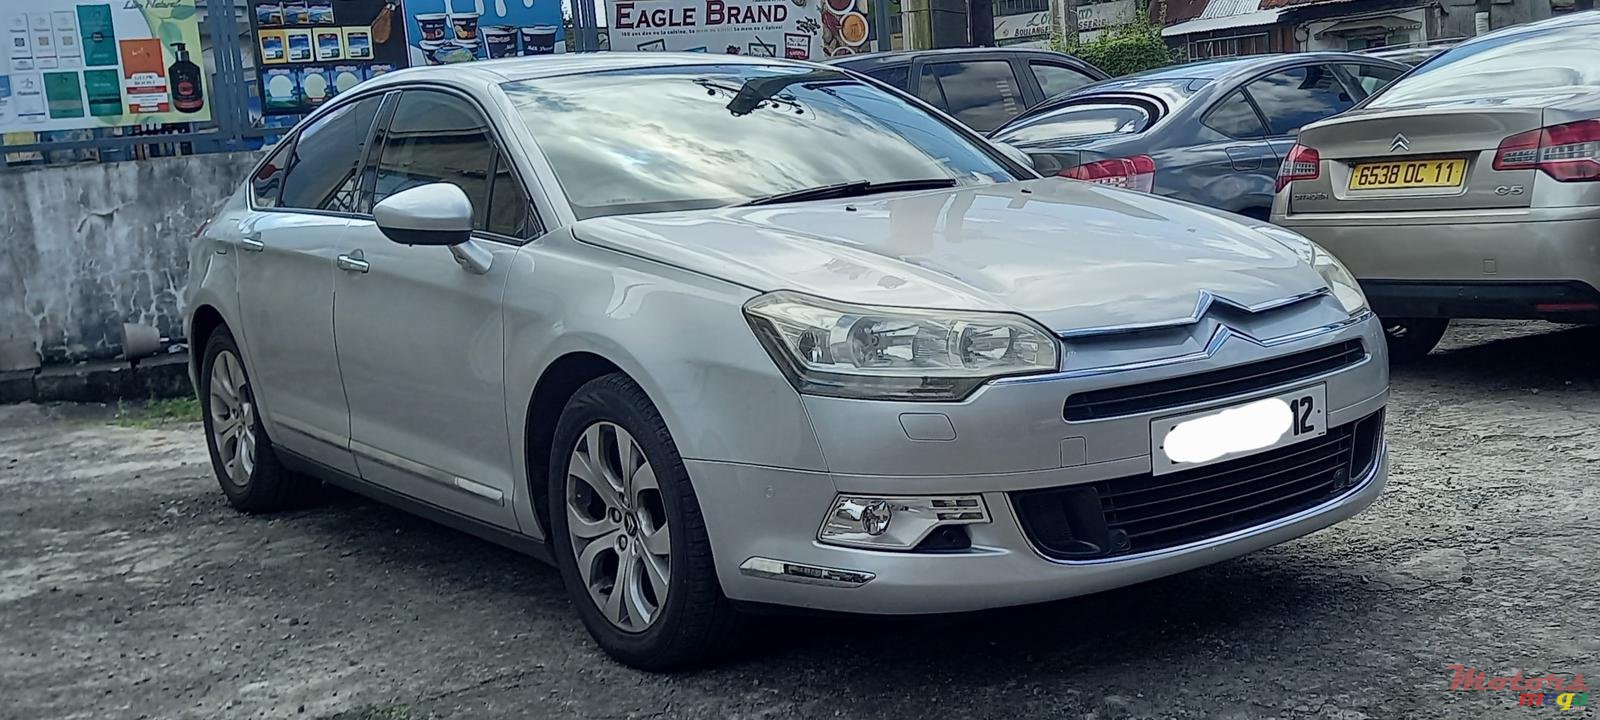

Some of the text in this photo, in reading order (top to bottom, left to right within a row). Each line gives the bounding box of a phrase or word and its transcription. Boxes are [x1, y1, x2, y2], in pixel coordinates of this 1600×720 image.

[615, 0, 788, 29] EAGLE BRAND
[1078, 18, 1106, 29] SSERIE
[1358, 162, 1455, 185] 6538 OC 11
[1494, 184, 1524, 196] C5
[1290, 395, 1314, 436] 12
